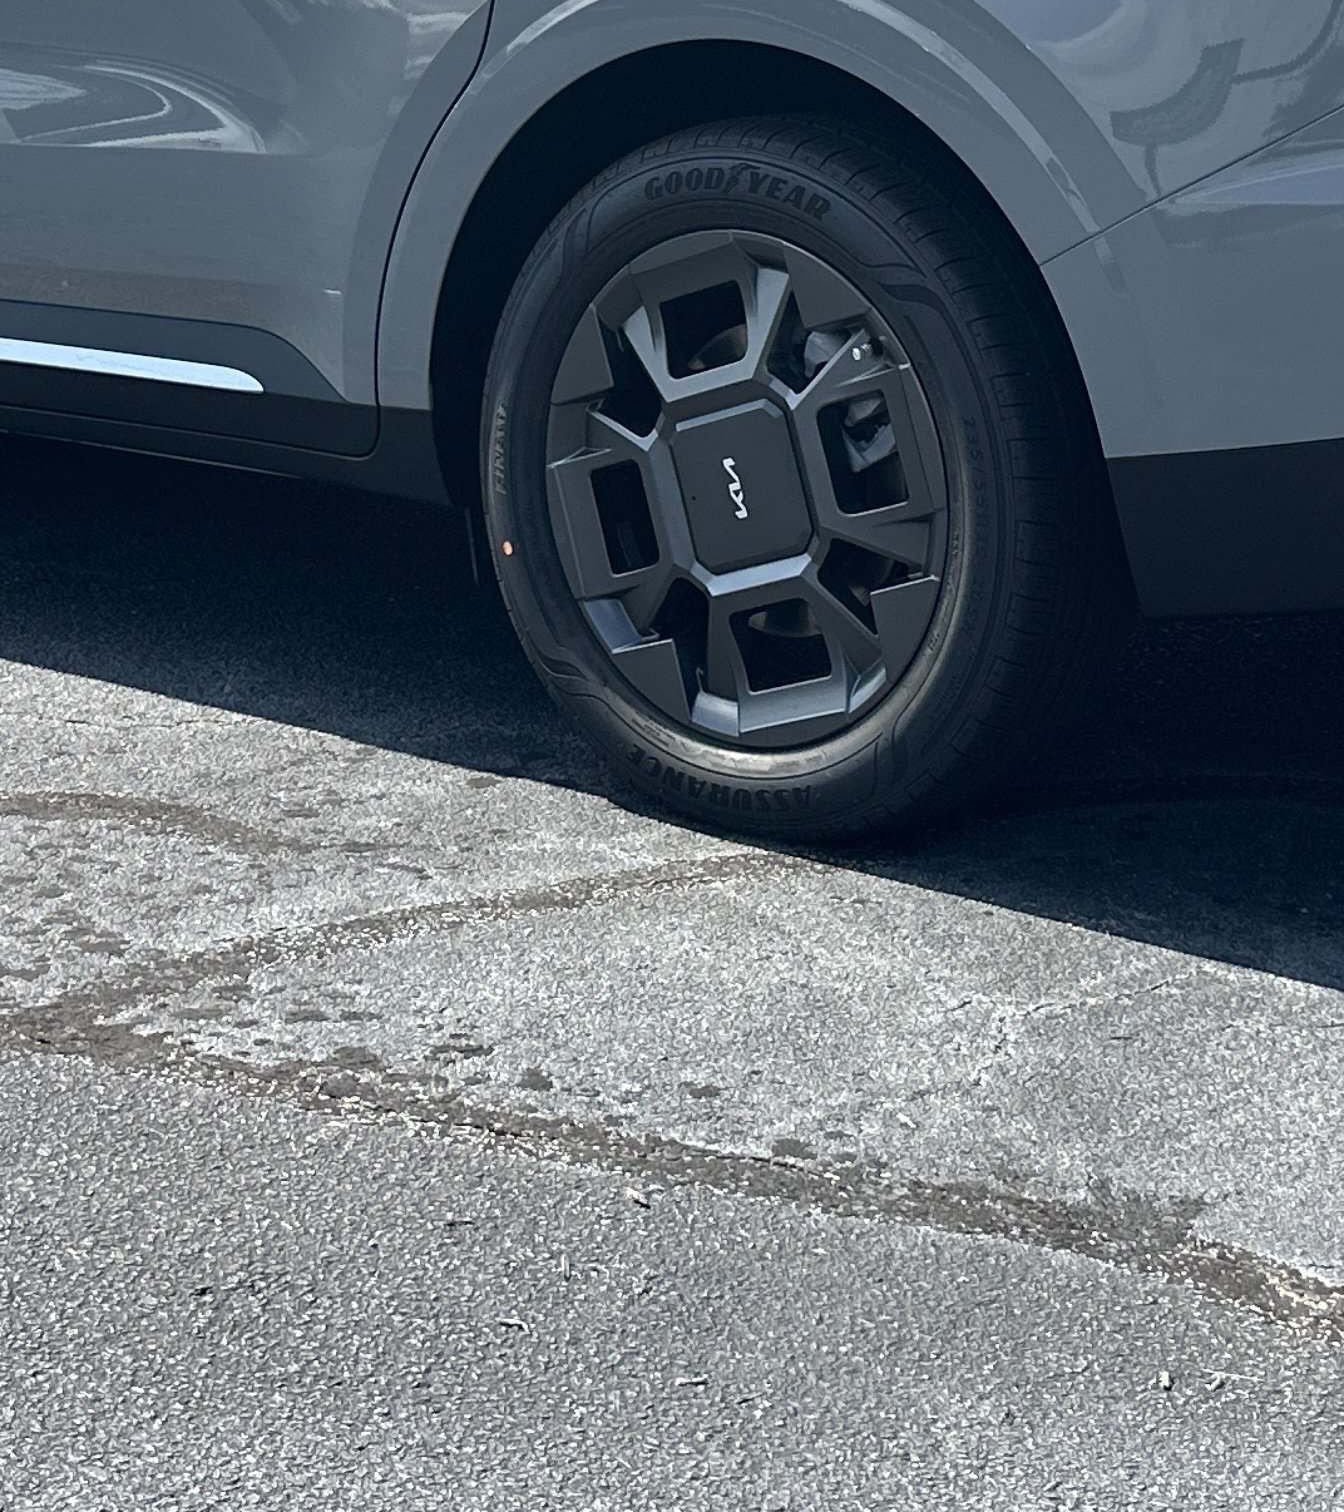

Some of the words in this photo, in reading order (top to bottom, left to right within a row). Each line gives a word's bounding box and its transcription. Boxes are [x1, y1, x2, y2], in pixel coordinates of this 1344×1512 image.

[644, 164, 831, 222] GOODYEAR
[721, 456, 748, 520] KIA
[624, 744, 812, 813] ASSURANCE
